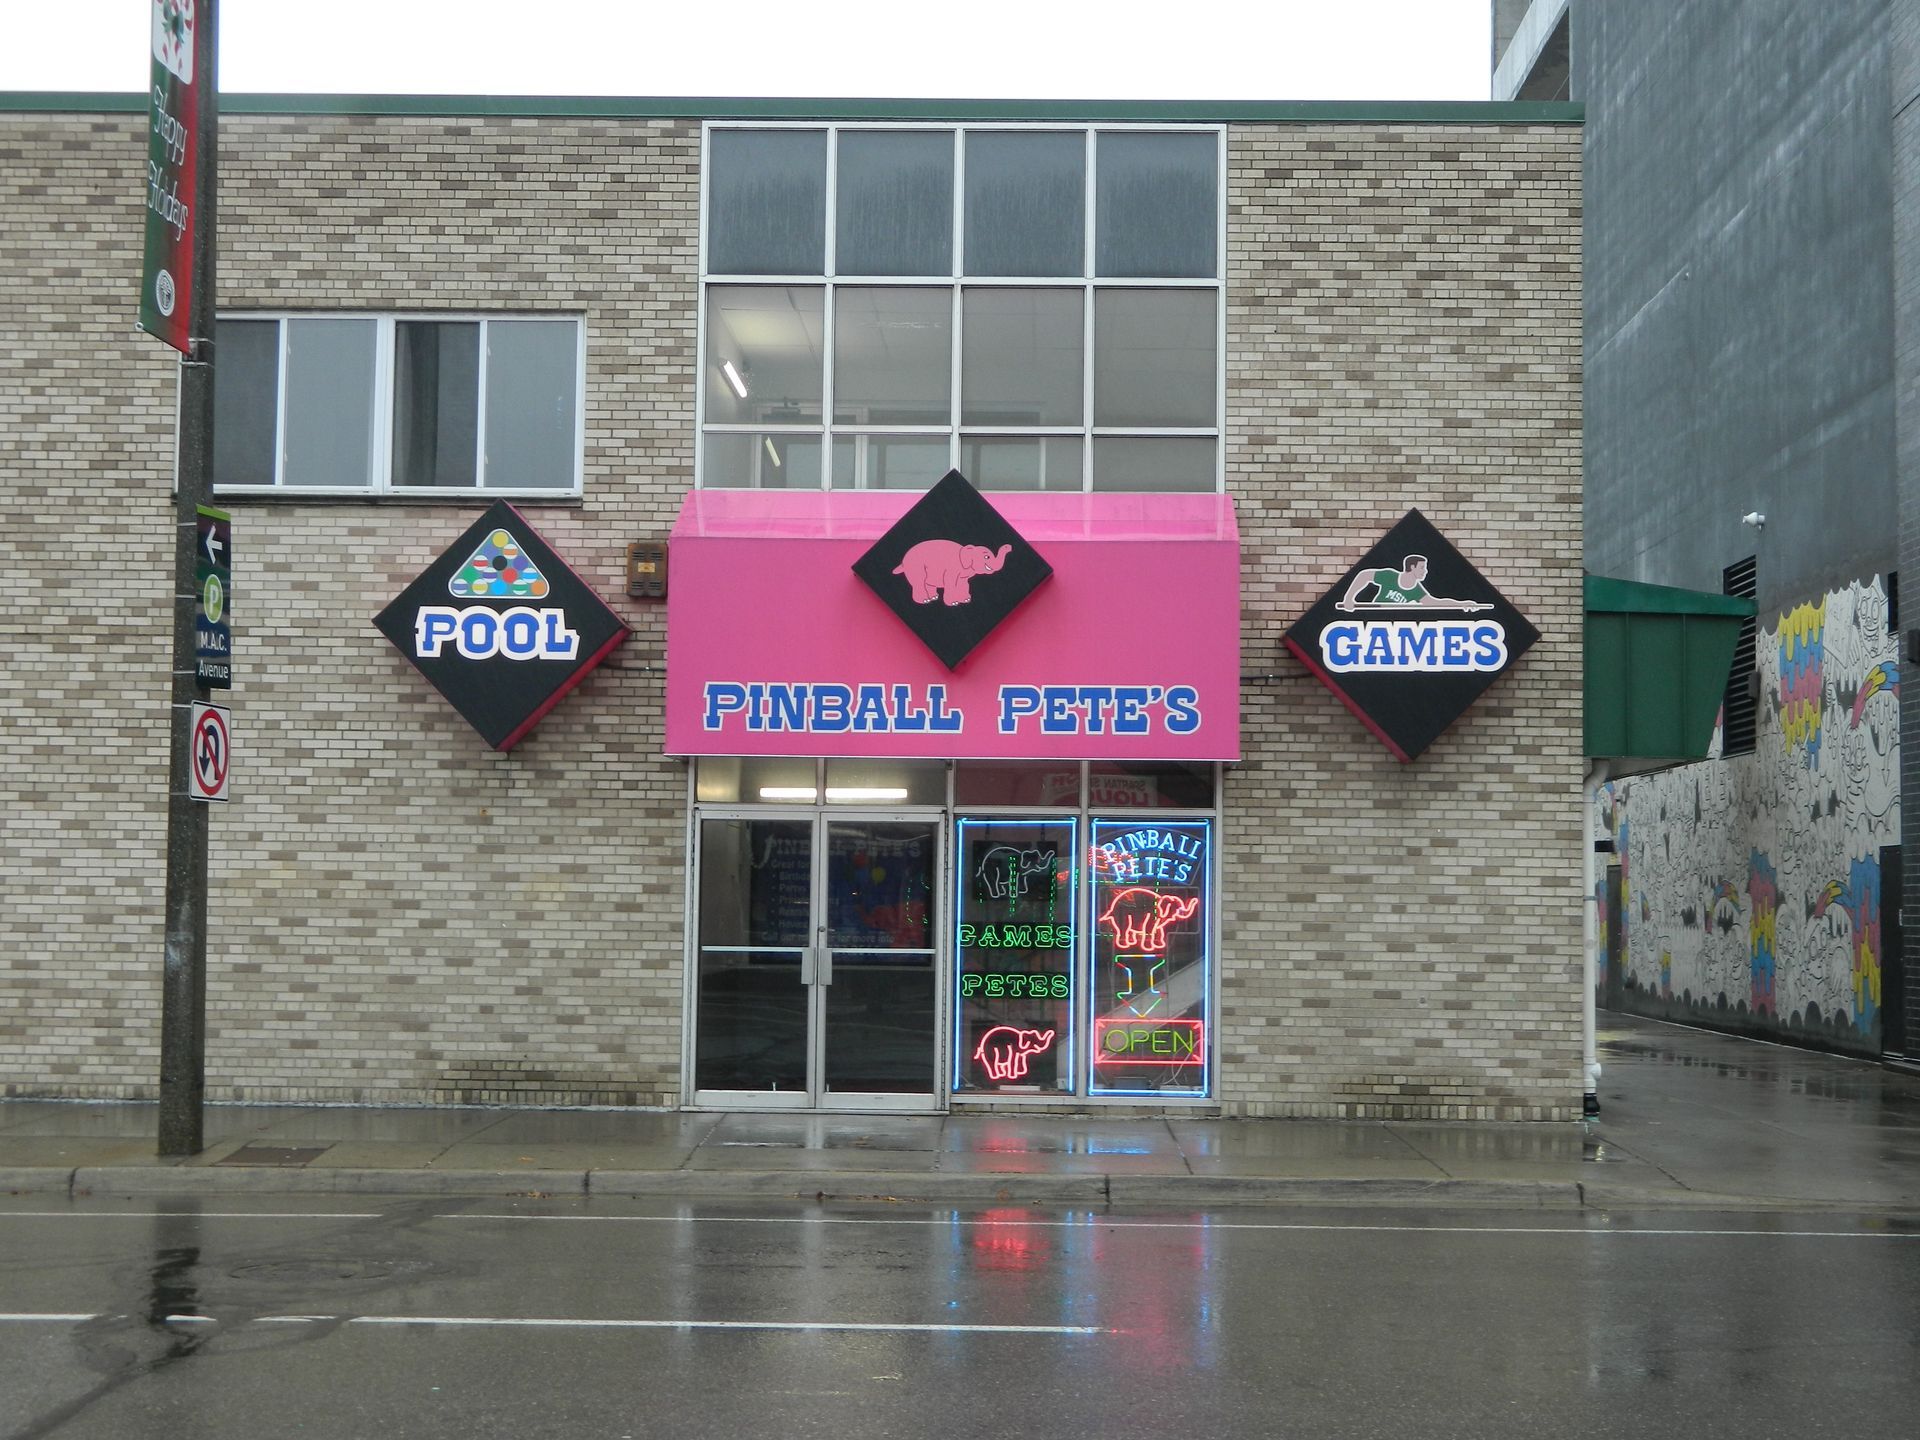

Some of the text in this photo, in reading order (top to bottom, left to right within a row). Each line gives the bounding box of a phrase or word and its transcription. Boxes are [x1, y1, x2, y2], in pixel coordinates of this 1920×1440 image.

[153, 84, 188, 167] Happy
[148, 159, 189, 242] Holidays
[200, 632, 228, 652] M.A.C.
[417, 607, 578, 659] POOL
[1321, 622, 1505, 671] GAMES
[198, 660, 229, 680] Avenue
[703, 682, 1201, 735] PINBALL PETE'S
[1111, 856, 1192, 882] PETE'S
[958, 924, 1073, 948] GAMES
[962, 974, 1071, 999] PETES
[1105, 1029, 1195, 1054] OPEN
